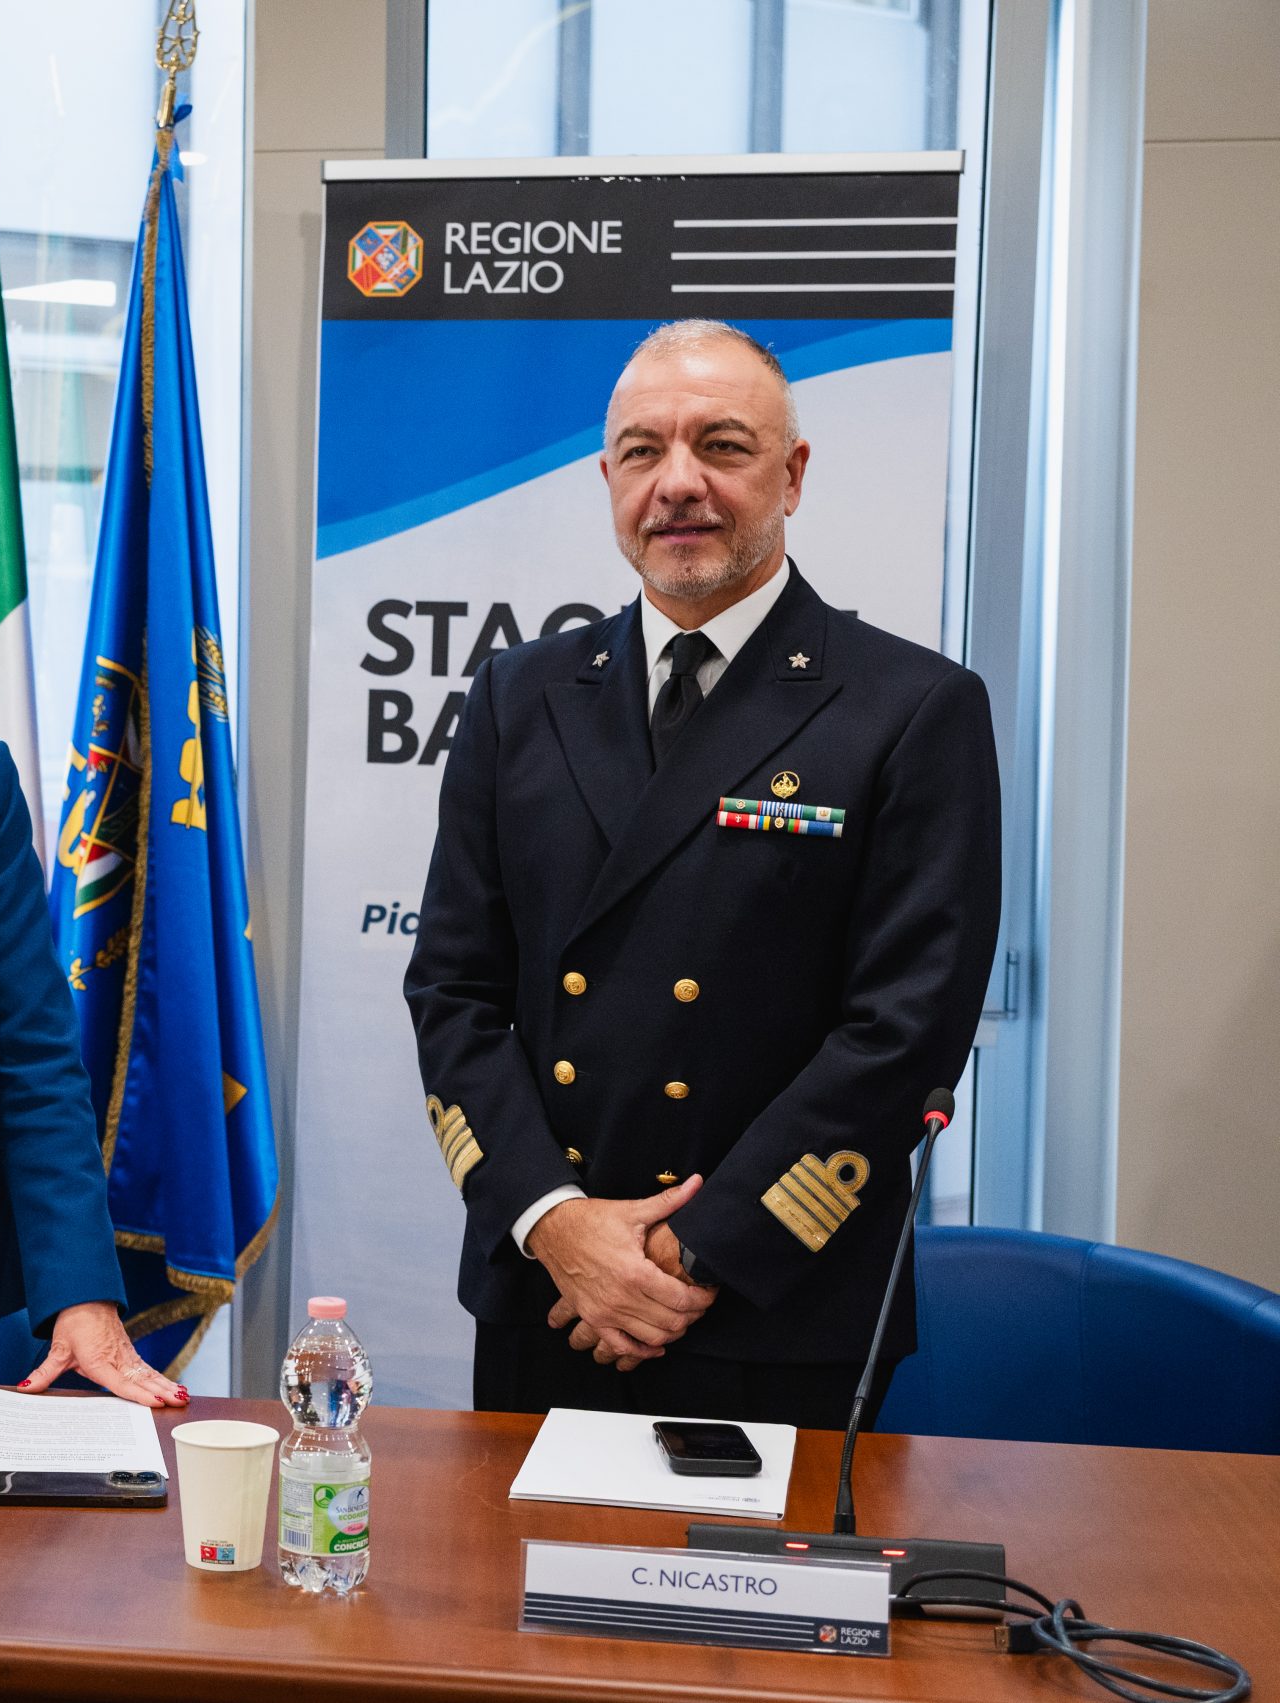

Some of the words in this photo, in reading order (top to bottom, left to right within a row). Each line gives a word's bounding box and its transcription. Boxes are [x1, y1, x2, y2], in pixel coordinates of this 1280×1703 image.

[444, 221, 622, 255] REGIONE
[443, 260, 564, 294] LAZIO
[367, 688, 469, 766] BA
[361, 901, 421, 936] Pia
[631, 1567, 653, 1586] C.
[659, 1569, 778, 1596] NICASTRO
[840, 1627, 881, 1639] REGIONE
[840, 1636, 869, 1646] LAZIO
